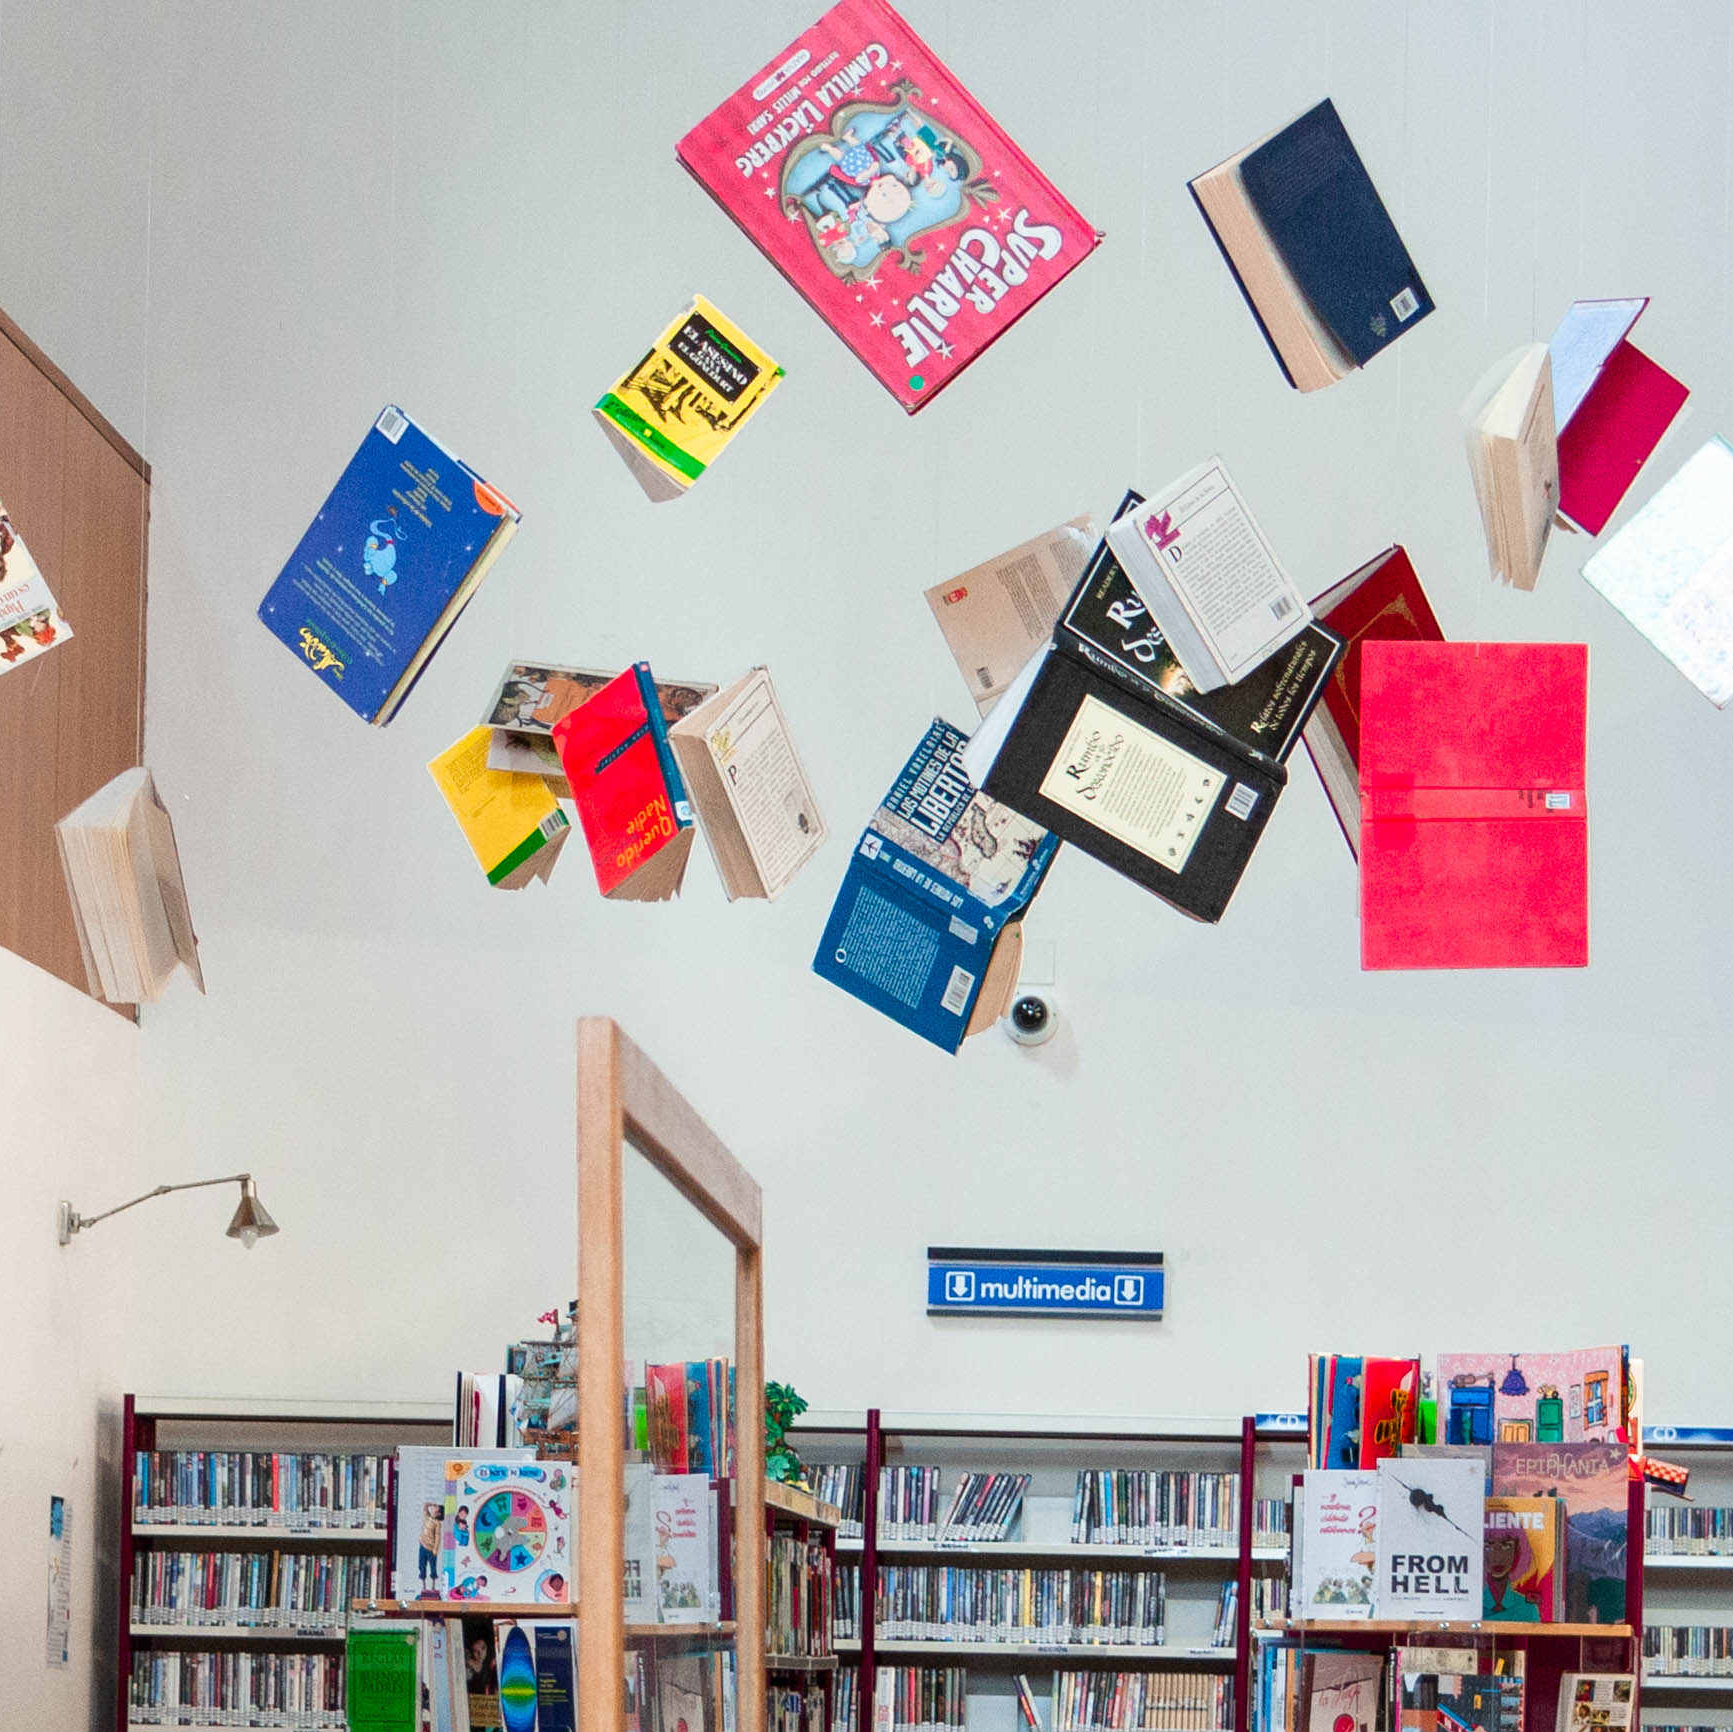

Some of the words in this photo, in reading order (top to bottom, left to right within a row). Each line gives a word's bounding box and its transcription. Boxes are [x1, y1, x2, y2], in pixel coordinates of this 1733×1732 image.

[964, 209, 1064, 314] SUPER
[891, 227, 1001, 368] CHARLIE
[897, 796, 917, 818] LOS
[909, 757, 942, 800] MOTINES
[933, 744, 949, 760] DE
[942, 731, 958, 747] LA
[627, 793, 667, 836] Nadie
[616, 815, 672, 868] Querido
[981, 1276, 1111, 1301] multimedia
[1275, 1415, 1299, 1429] CD
[1653, 1426, 1677, 1441] CD
[1516, 1455, 1610, 1480] EPIPHANIA
[1391, 1555, 1469, 1574] FROM
[1391, 1575, 1470, 1595] HELL
